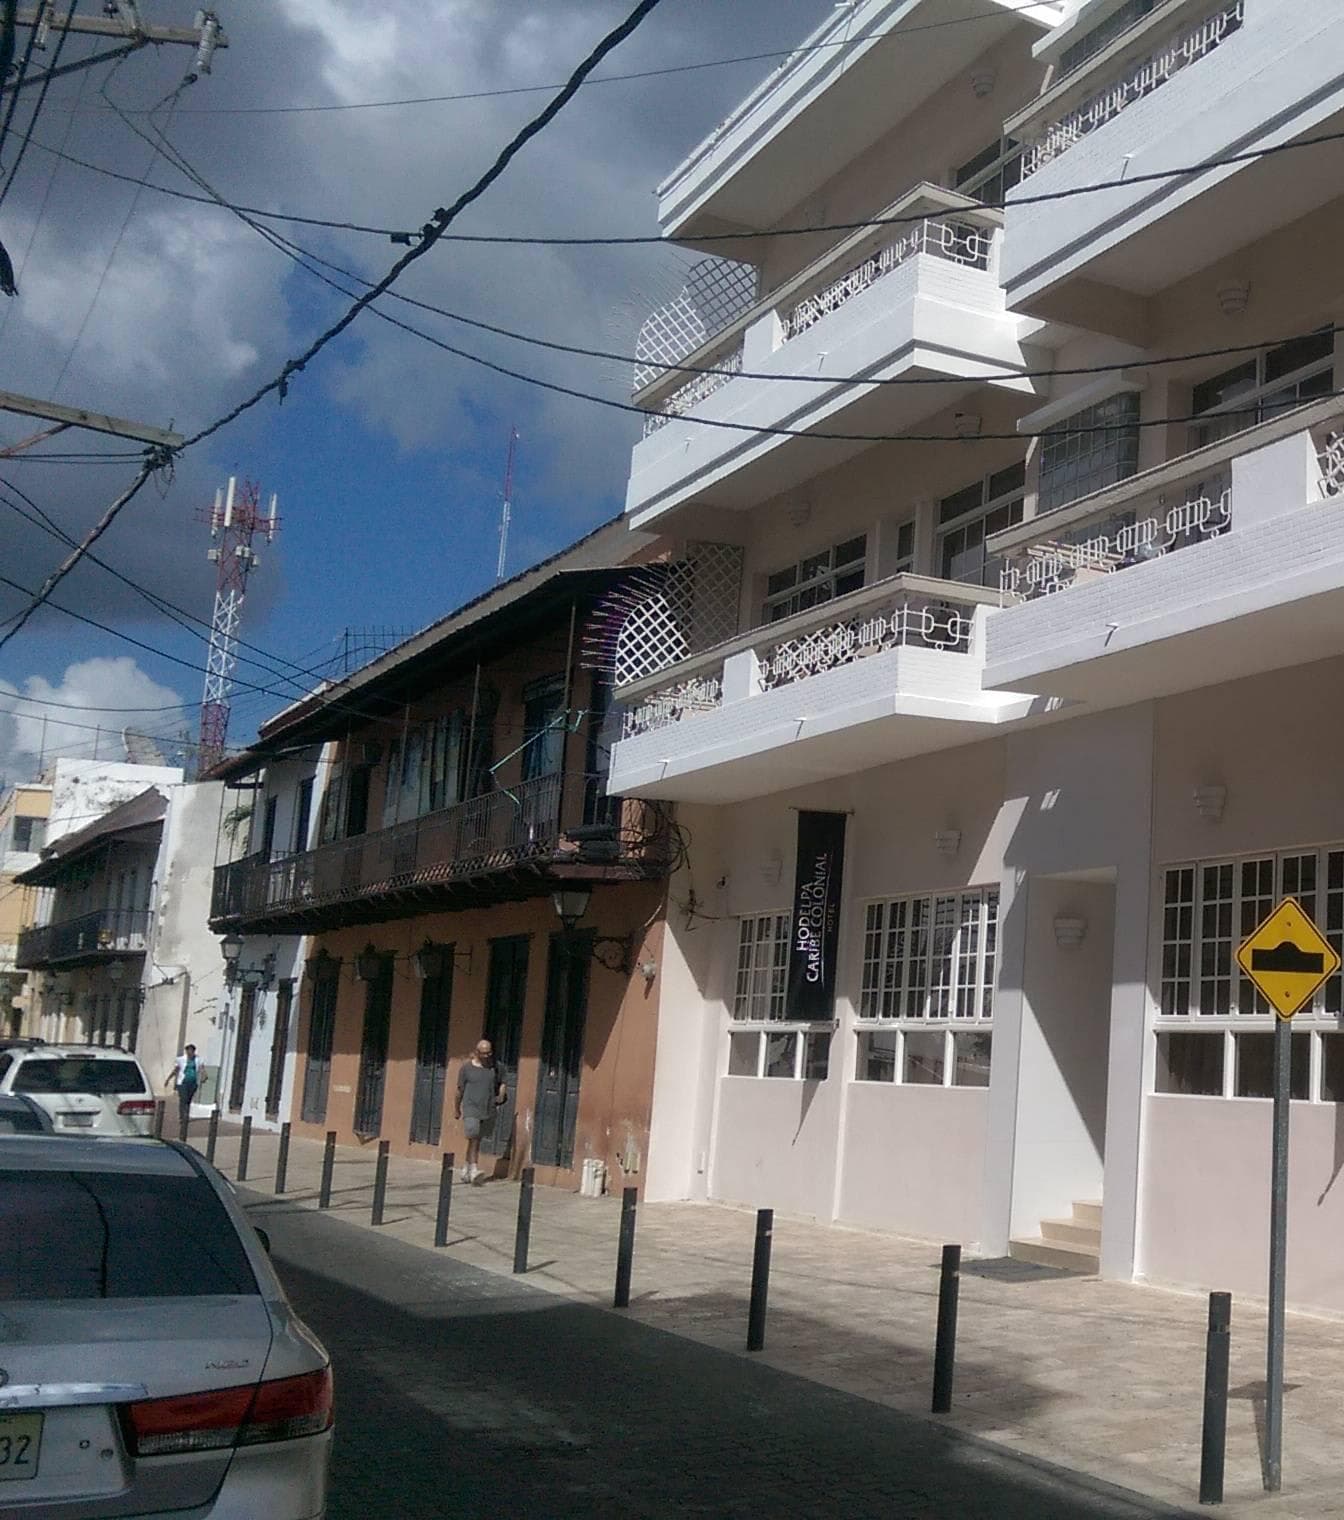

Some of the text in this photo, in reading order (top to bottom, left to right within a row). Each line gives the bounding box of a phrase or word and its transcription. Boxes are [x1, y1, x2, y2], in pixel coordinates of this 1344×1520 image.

[796, 882, 813, 951] HODELPA
[806, 853, 827, 982] CARIBE COLONIAL
[827, 903, 836, 932] HOTEL
